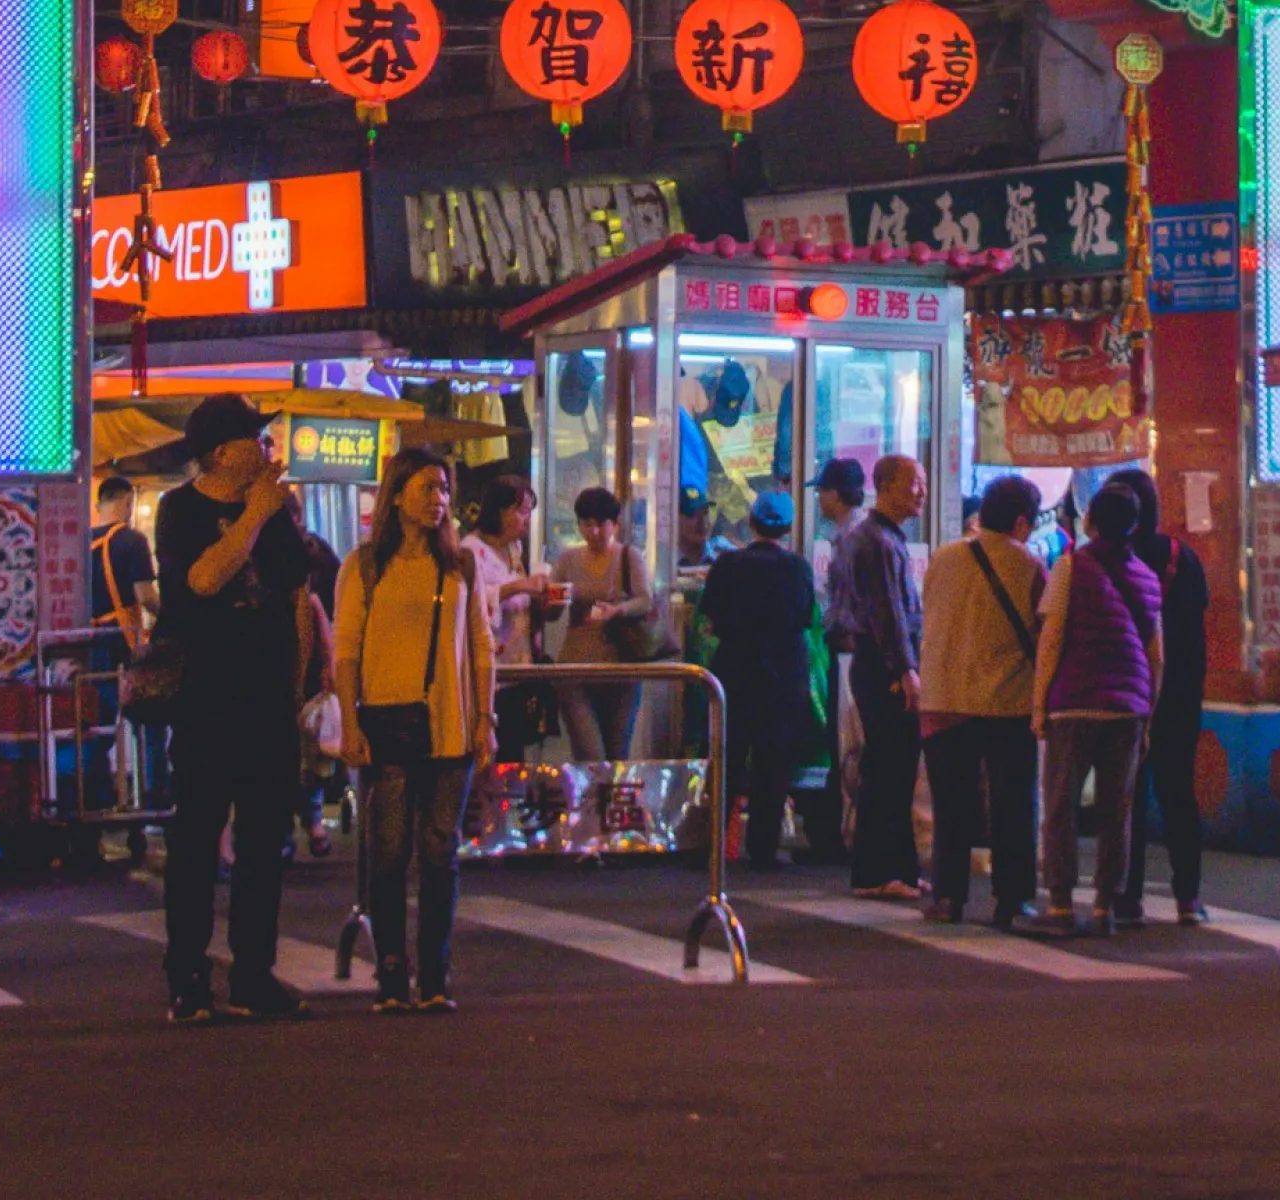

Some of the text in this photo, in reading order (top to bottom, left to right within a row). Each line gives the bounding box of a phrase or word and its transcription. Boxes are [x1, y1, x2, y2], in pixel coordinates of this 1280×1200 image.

[867, 180, 1120, 271] 健和藥粧
[854, 287, 942, 323] 服務台
